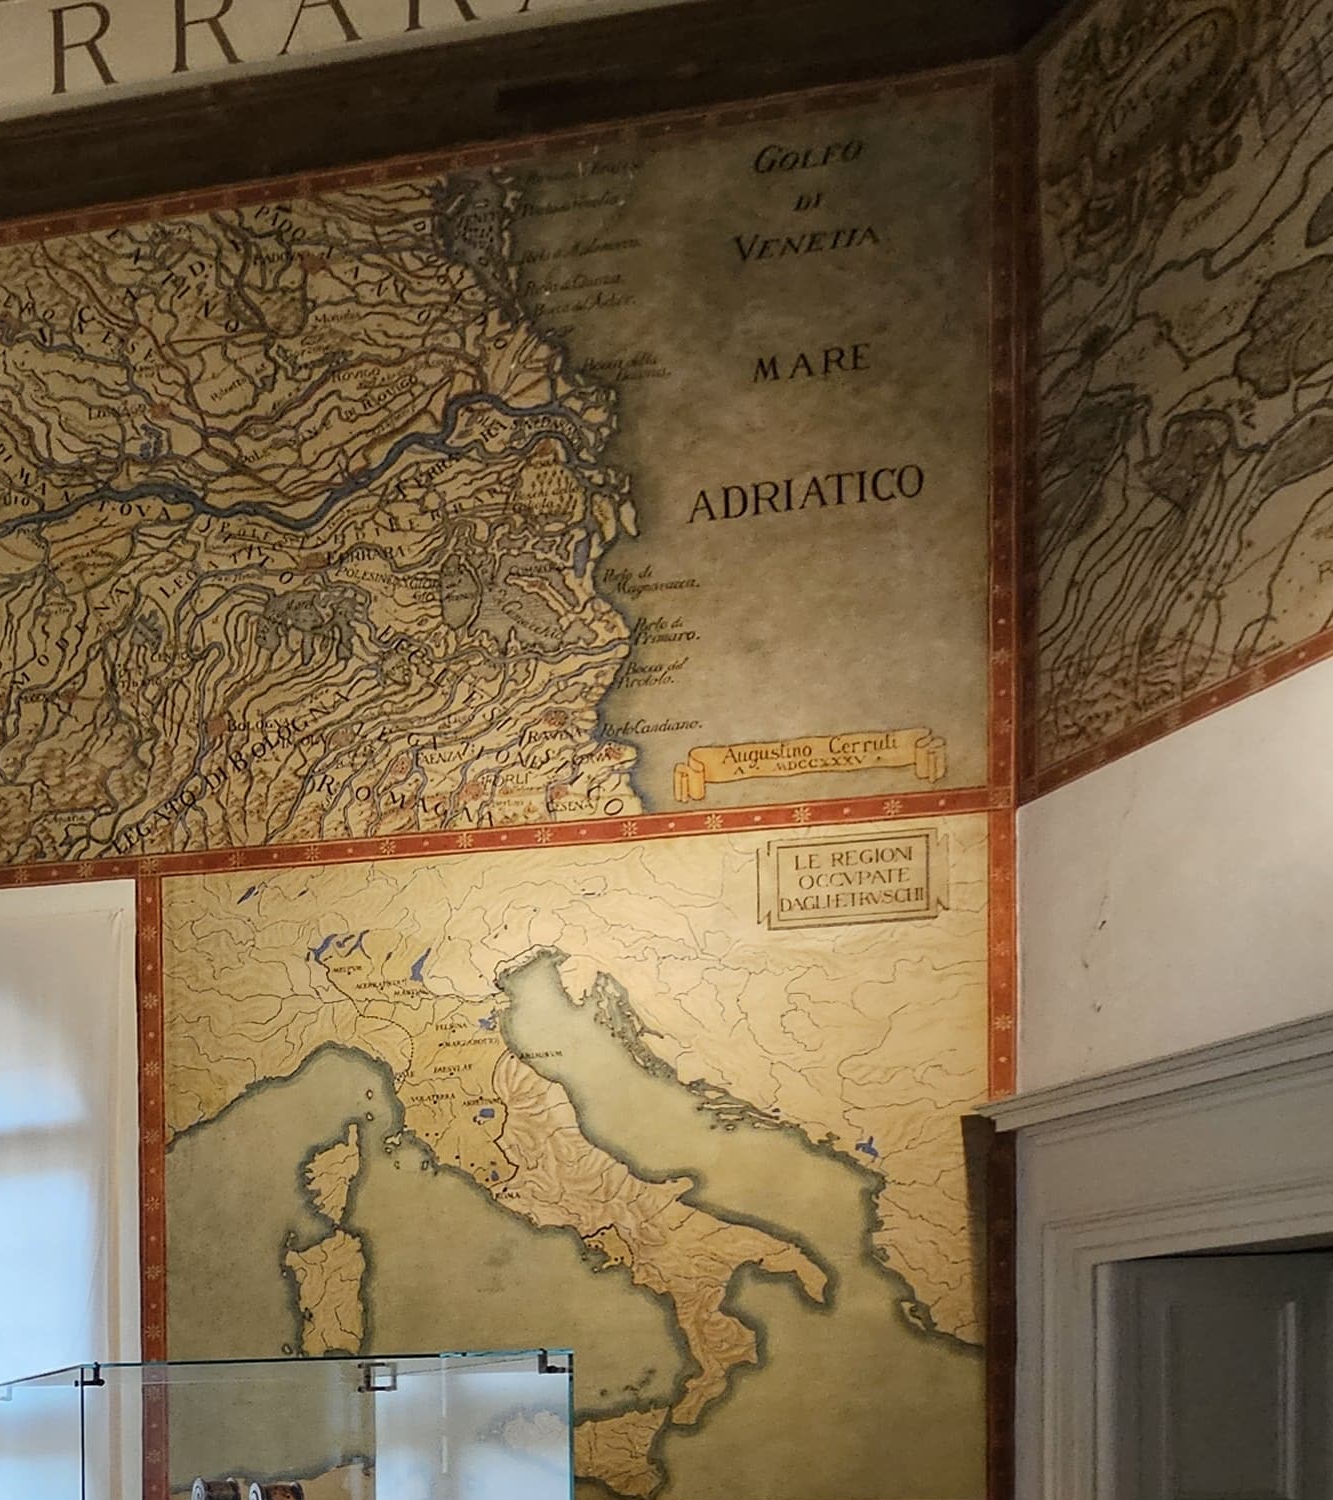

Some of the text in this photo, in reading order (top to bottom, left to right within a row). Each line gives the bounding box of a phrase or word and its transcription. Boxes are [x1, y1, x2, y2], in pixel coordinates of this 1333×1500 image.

[753, 342, 871, 384] MARE
[687, 464, 925, 524] ADRIATICO
[794, 845, 913, 873] LE REGIONI
[798, 866, 911, 889] OCCVPATE
